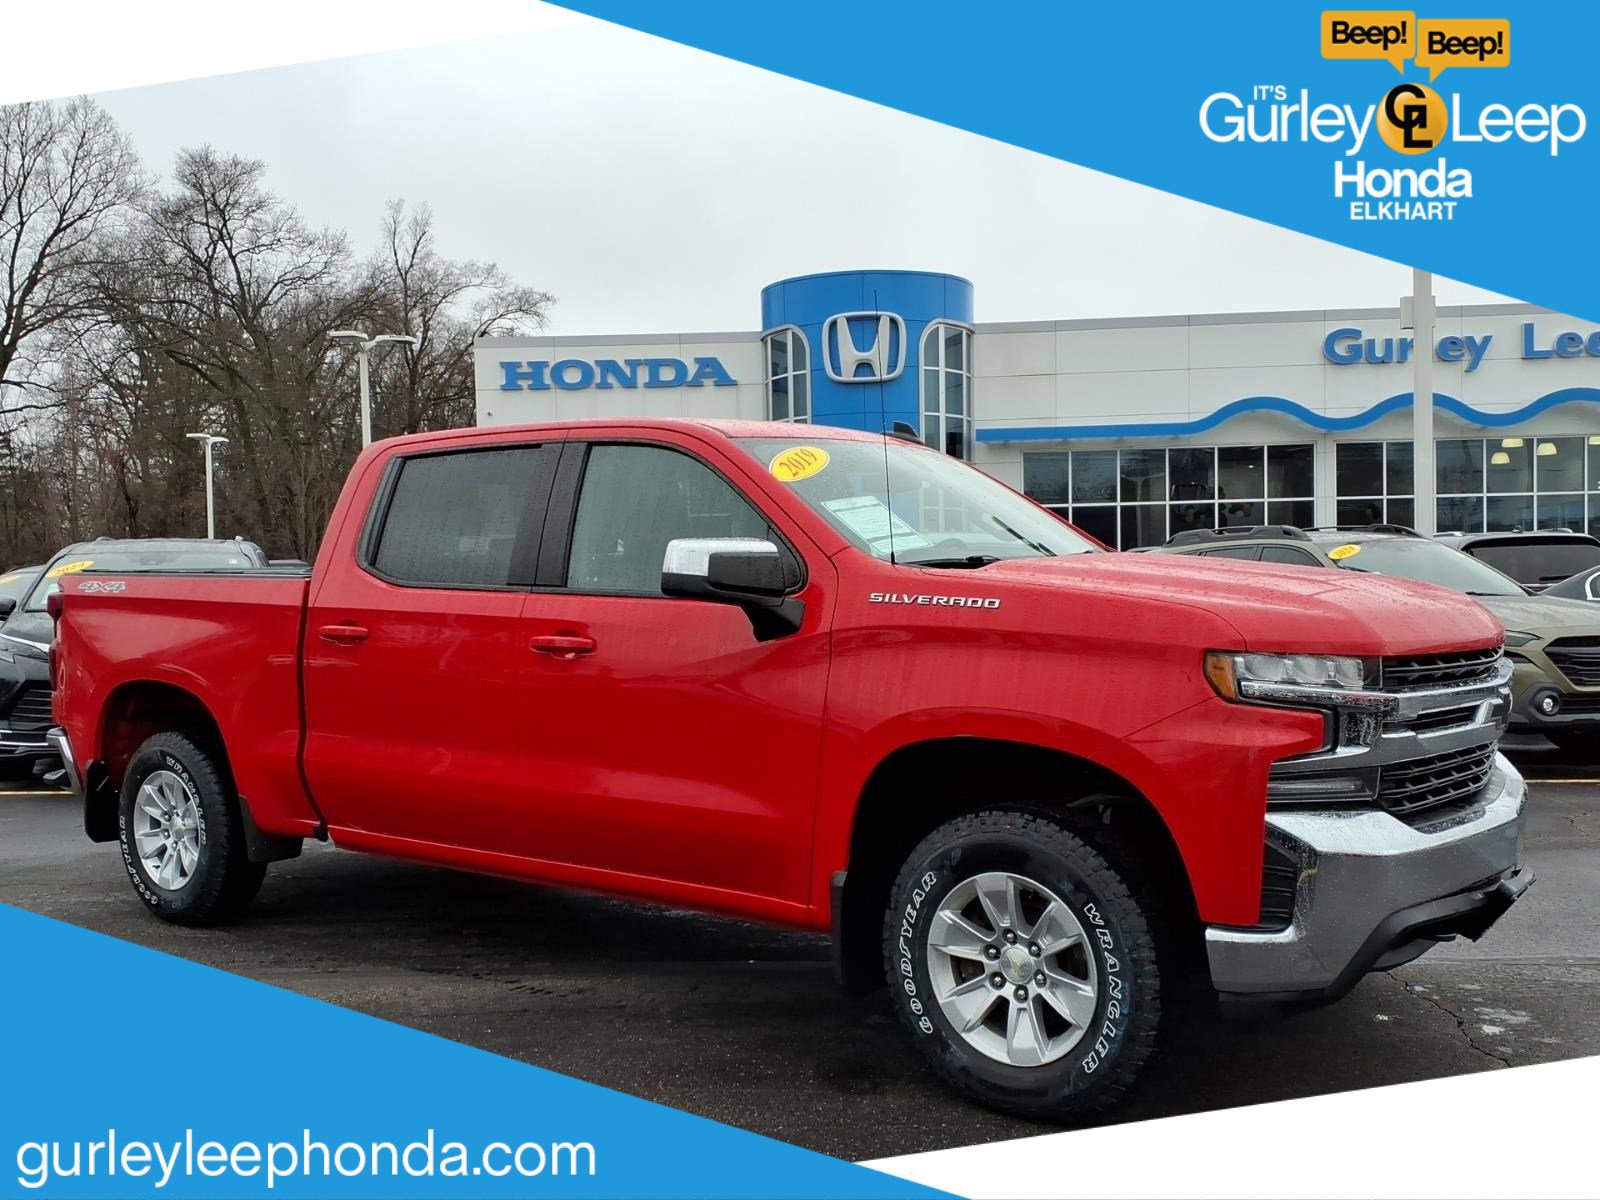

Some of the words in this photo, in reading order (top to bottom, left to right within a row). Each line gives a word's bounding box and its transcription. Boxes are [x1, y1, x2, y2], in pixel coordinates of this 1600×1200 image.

[1323, 327, 1493, 372] Gurey
[500, 356, 738, 391] HONDA
[779, 448, 817, 477] 2019
[868, 592, 1001, 609] SILVERADO
[899, 871, 937, 1034] GOODYEAR
[1082, 903, 1123, 1074] WRANGLER
